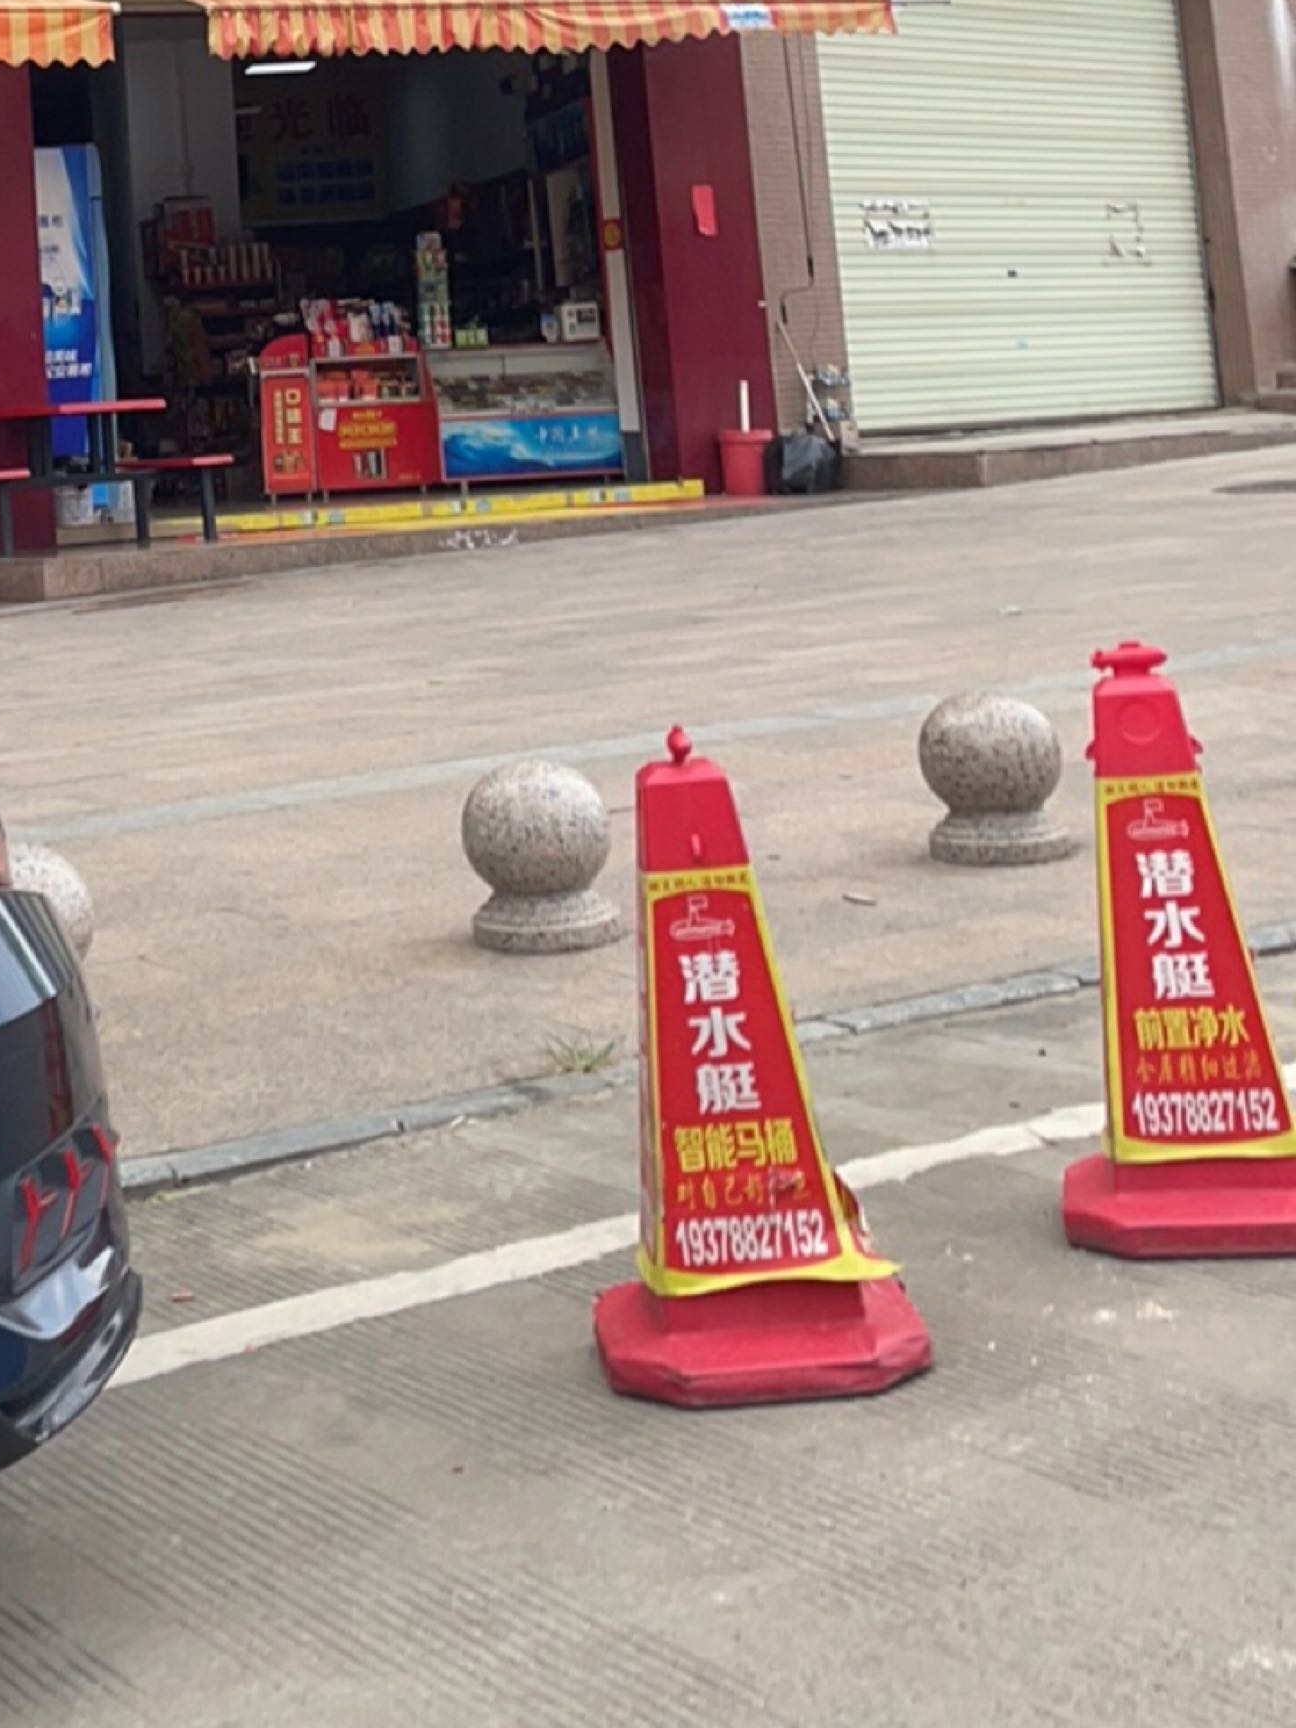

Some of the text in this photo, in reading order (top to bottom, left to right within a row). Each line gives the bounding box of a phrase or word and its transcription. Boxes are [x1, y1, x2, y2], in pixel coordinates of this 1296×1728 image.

[1135, 849, 1215, 1000] 潜水艇
[678, 950, 761, 1115] 潜水艇
[1133, 1004, 1250, 1051] 前置净水
[1132, 1087, 1281, 1138] 19378827152
[674, 1117, 799, 1173] 智能马桶
[676, 1210, 829, 1267] 19378827152
